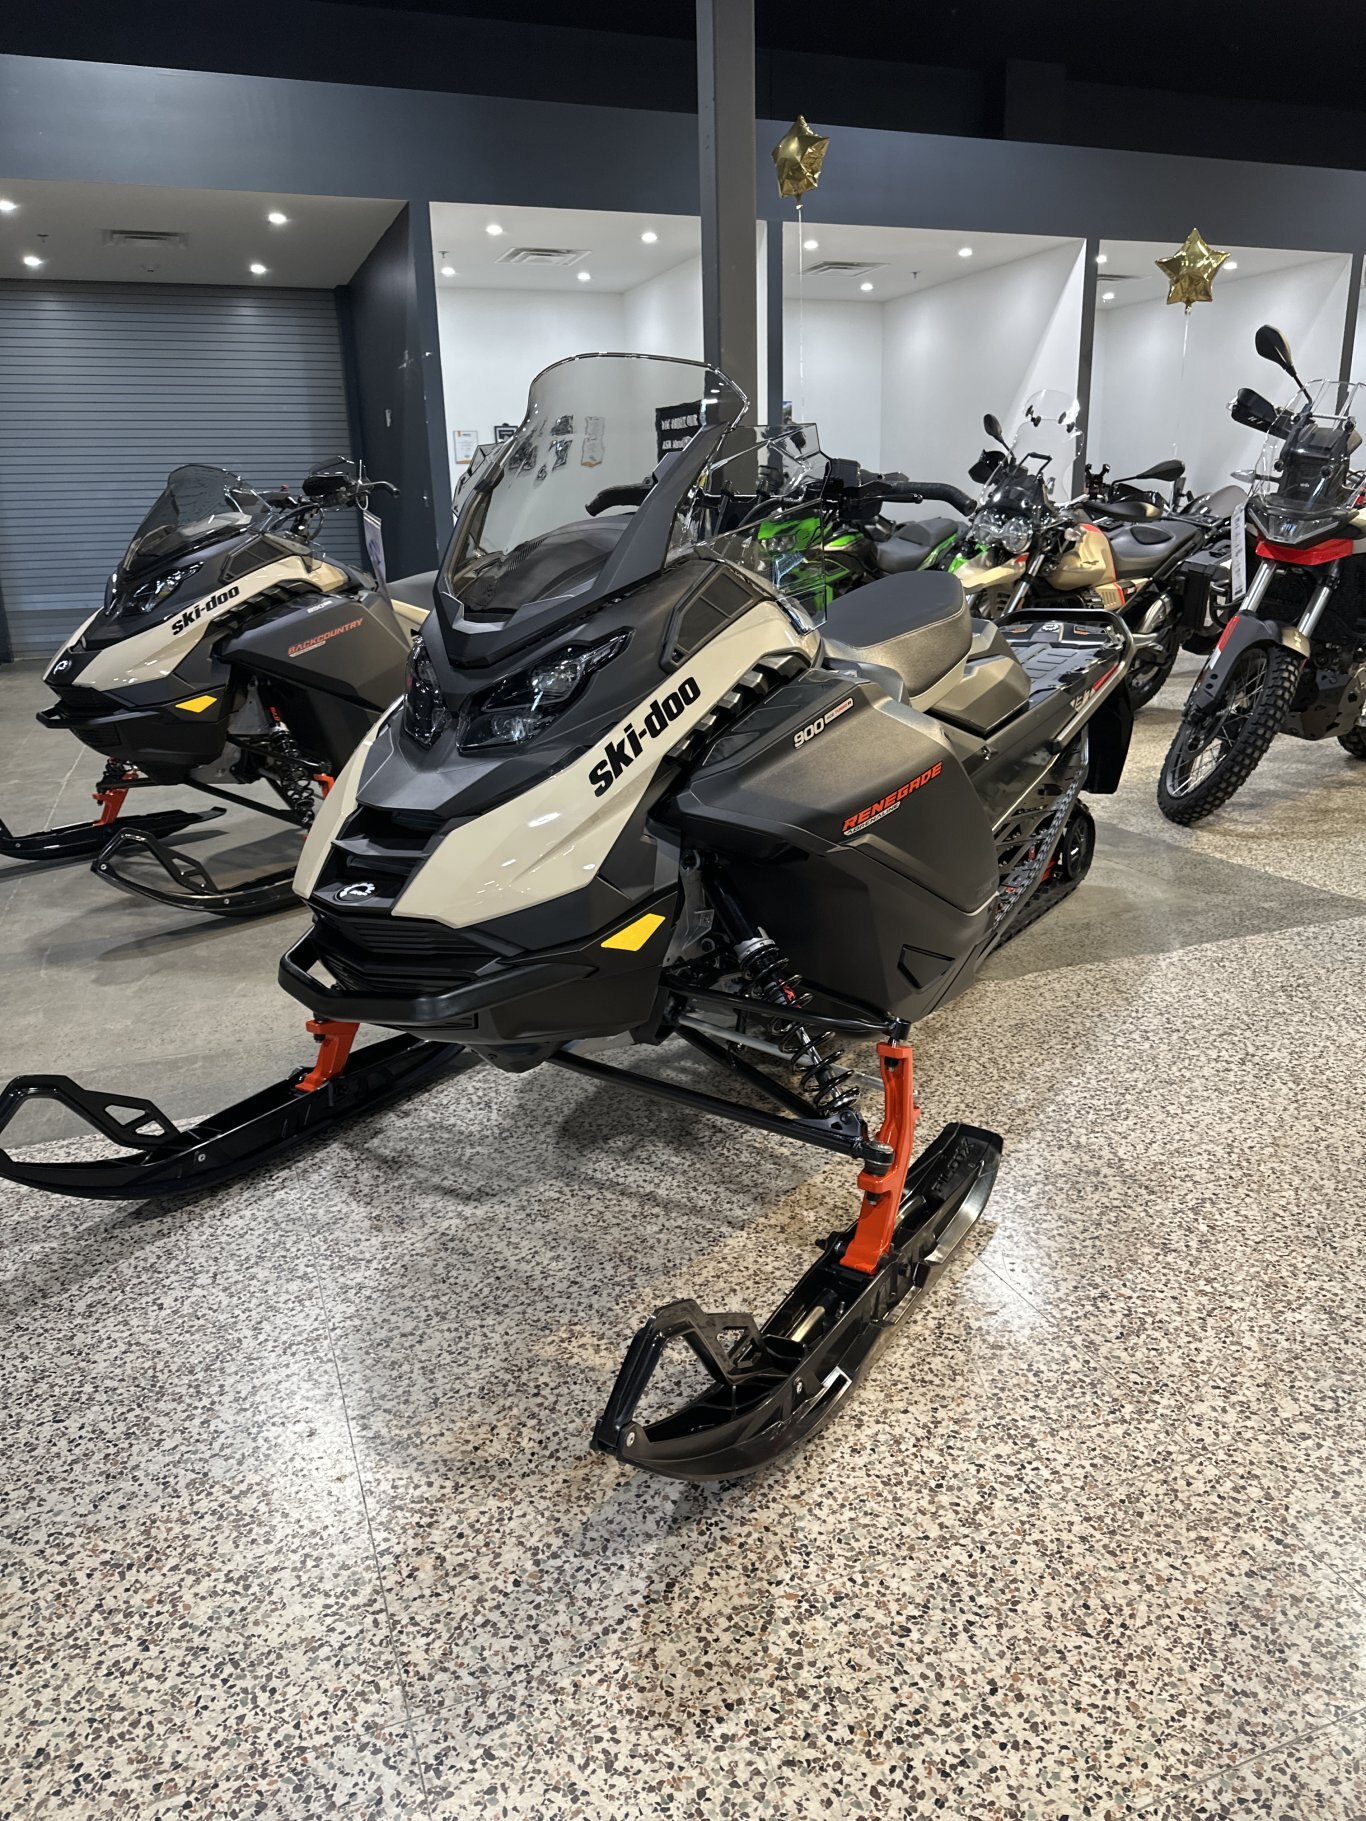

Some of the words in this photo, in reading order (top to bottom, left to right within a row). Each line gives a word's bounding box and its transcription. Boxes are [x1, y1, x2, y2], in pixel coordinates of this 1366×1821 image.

[171, 586, 240, 636] ski-doo
[288, 617, 364, 655] BACKCOUNTRY
[588, 676, 702, 798] ski-doo
[793, 718, 825, 748] 900
[842, 760, 943, 832] RENEGADE
